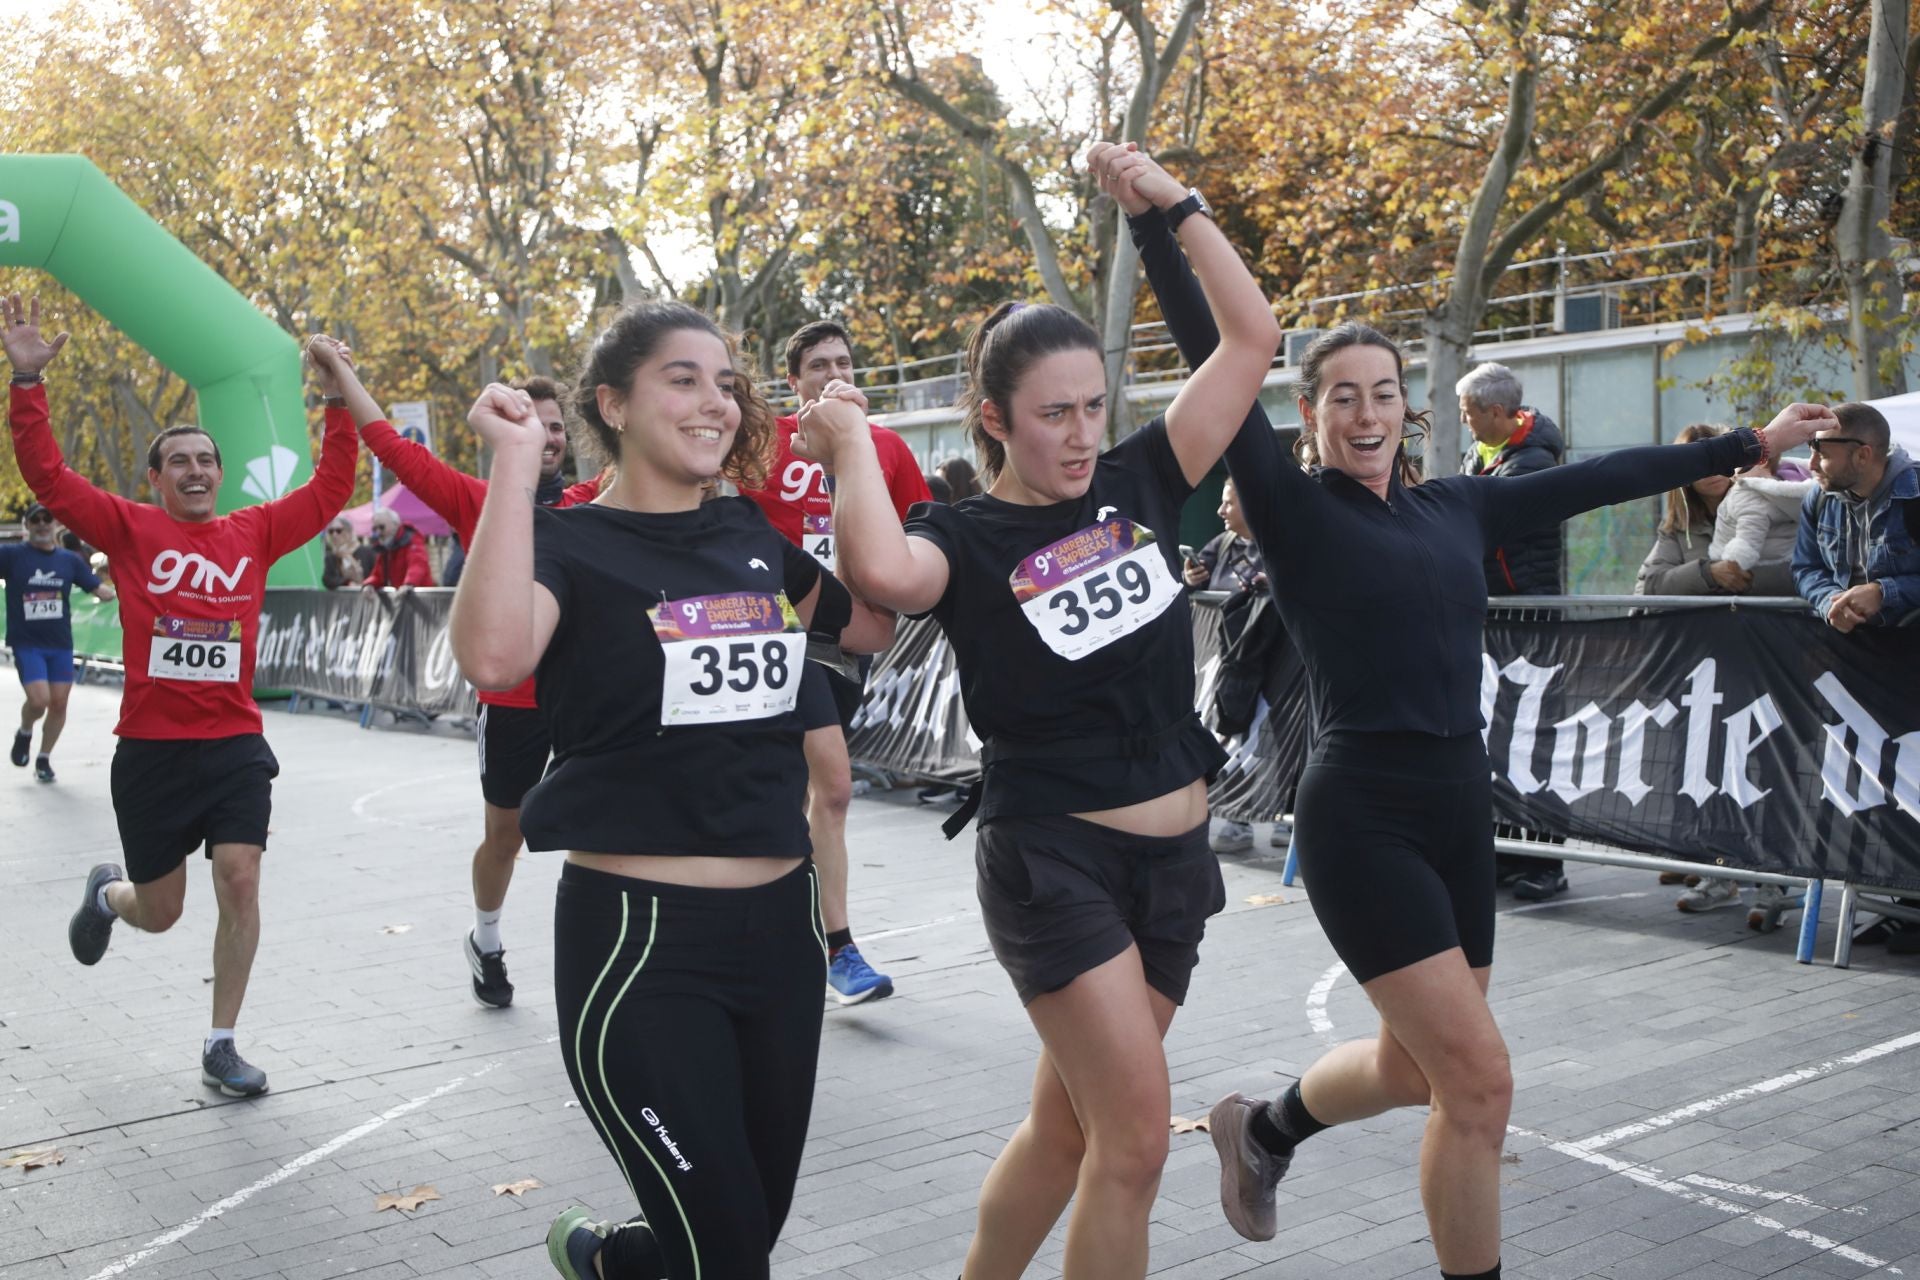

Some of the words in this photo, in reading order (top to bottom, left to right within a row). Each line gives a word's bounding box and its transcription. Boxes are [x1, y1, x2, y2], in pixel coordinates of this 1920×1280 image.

[813, 537, 836, 560] 4
[1052, 533, 1093, 557] CARRERA
[1092, 527, 1105, 540] DE
[1056, 538, 1110, 567] EMPRESAS
[31, 602, 57, 614] 736
[218, 594, 252, 604] SOLUTIONS
[703, 598, 748, 610] CARRERA
[749, 597, 758, 607] DE
[1049, 560, 1151, 636] 359
[707, 606, 762, 623] EMPRESAS
[162, 642, 227, 669] 406
[689, 640, 789, 696] 358
[654, 1125, 693, 1171] Kalenji
